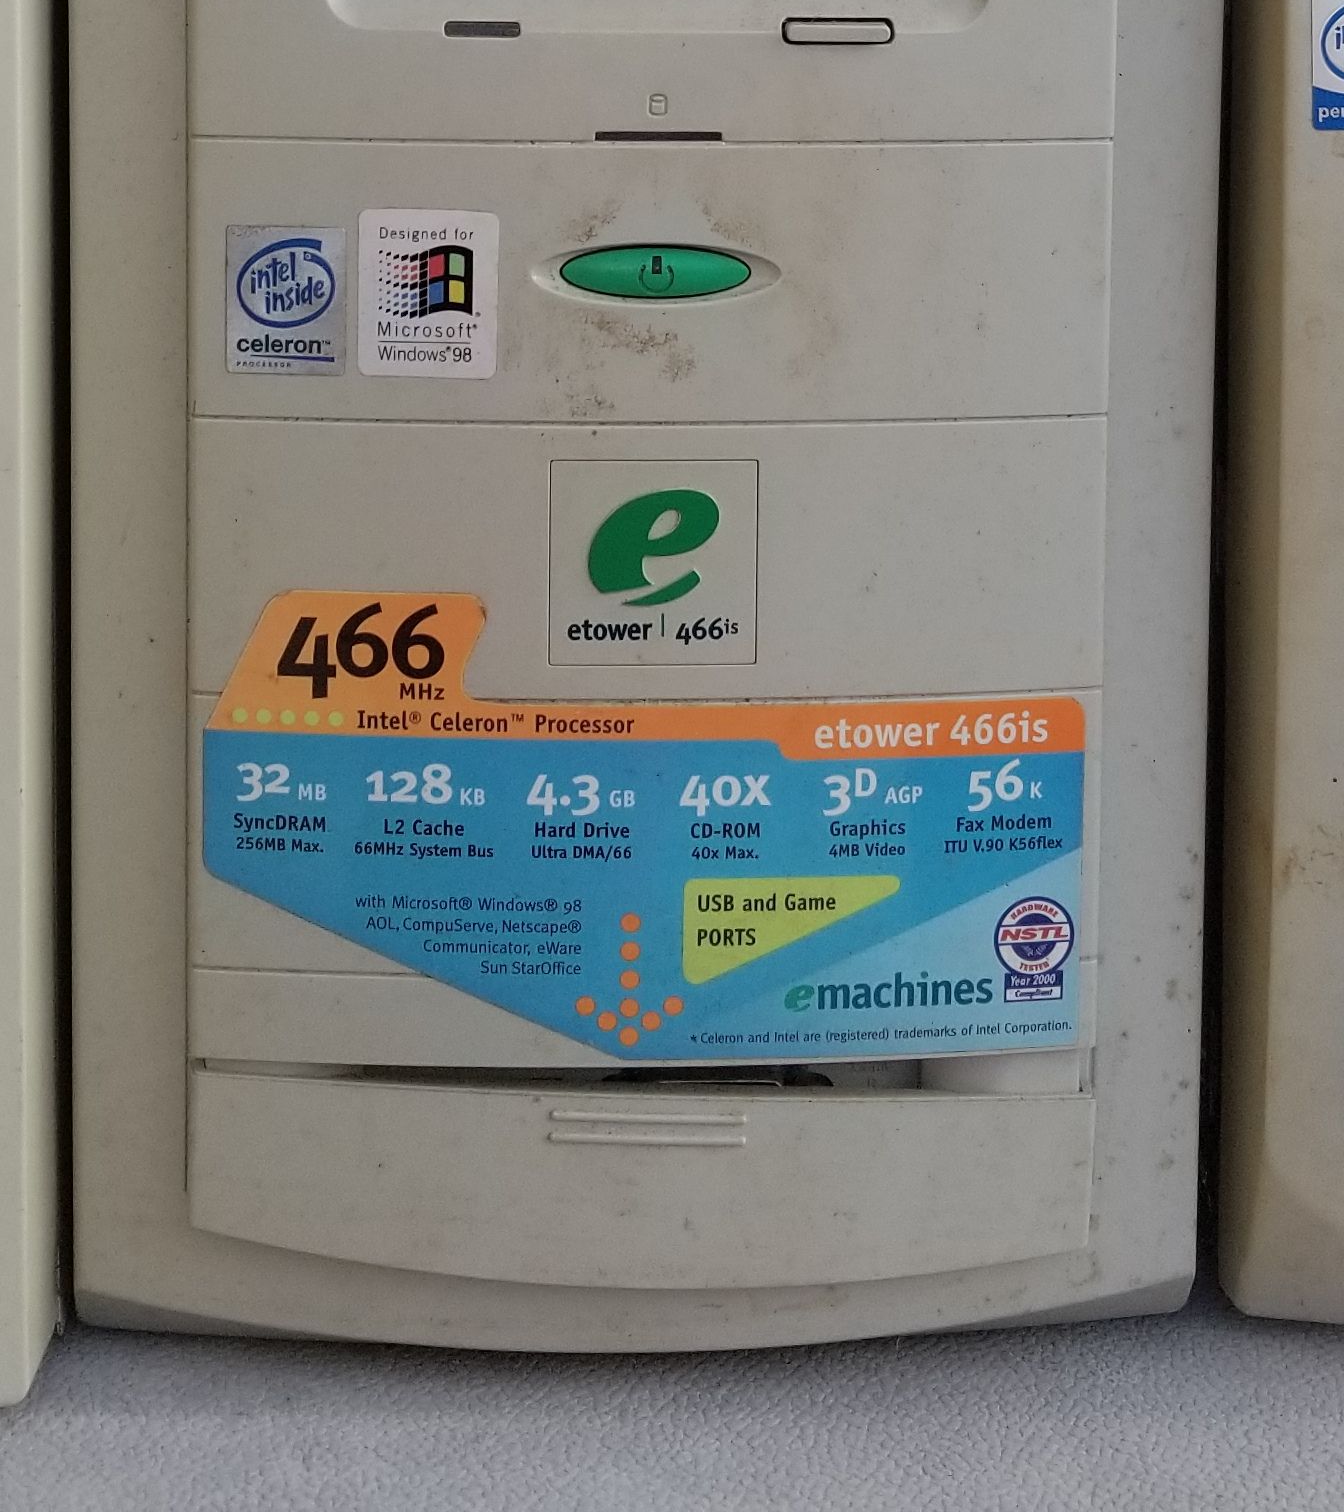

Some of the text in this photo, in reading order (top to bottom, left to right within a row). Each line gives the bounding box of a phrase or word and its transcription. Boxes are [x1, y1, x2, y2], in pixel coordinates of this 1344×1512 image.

[379, 226, 475, 241] Designed for
[249, 251, 297, 295] intel
[264, 276, 326, 315] inside
[451, 347, 472, 363] 98
[566, 618, 653, 642] etower
[276, 602, 445, 699] 466
[399, 682, 445, 701] MHz
[534, 714, 635, 734] Processor
[814, 711, 1049, 749] etower 466is
[235, 762, 328, 802] 32 MB
[366, 763, 486, 807] 128 KB
[822, 767, 924, 817] 3D AGP
[967, 758, 1043, 813] 56 K
[526, 774, 636, 817] 4.3 GB
[233, 812, 327, 834] SyncDRAM
[383, 818, 465, 837] L2 Cache
[533, 821, 631, 839] Hard Drive
[690, 822, 762, 839] CD-ROM
[829, 820, 907, 840] Graphics
[955, 814, 1053, 834] Fax Modem
[235, 836, 324, 853] 256MB Max.
[354, 841, 495, 860] 66MHz System Bus
[531, 844, 632, 862] Ultra DMA/66
[691, 845, 760, 860] 40x Max.
[828, 842, 906, 858] 4MB Video
[944, 835, 1064, 855] ITU V.90 K56flex
[355, 894, 386, 909] with
[563, 899, 583, 915] 98
[696, 892, 837, 912] USB and Game
[365, 916, 400, 932] AOL,
[402, 917, 499, 935] CompuServe,
[1000, 926, 1069, 942] NSTL
[423, 938, 582, 956] Communicator, eWare
[696, 928, 757, 947] PORTS
[480, 960, 582, 976] Sun StarOffice
[1010, 973, 1056, 987] Year 2000
[783, 971, 994, 1013] emachines
[700, 1019, 1073, 1045] Celeron and Intel are (registered) trademarks of Intel Corporation.
